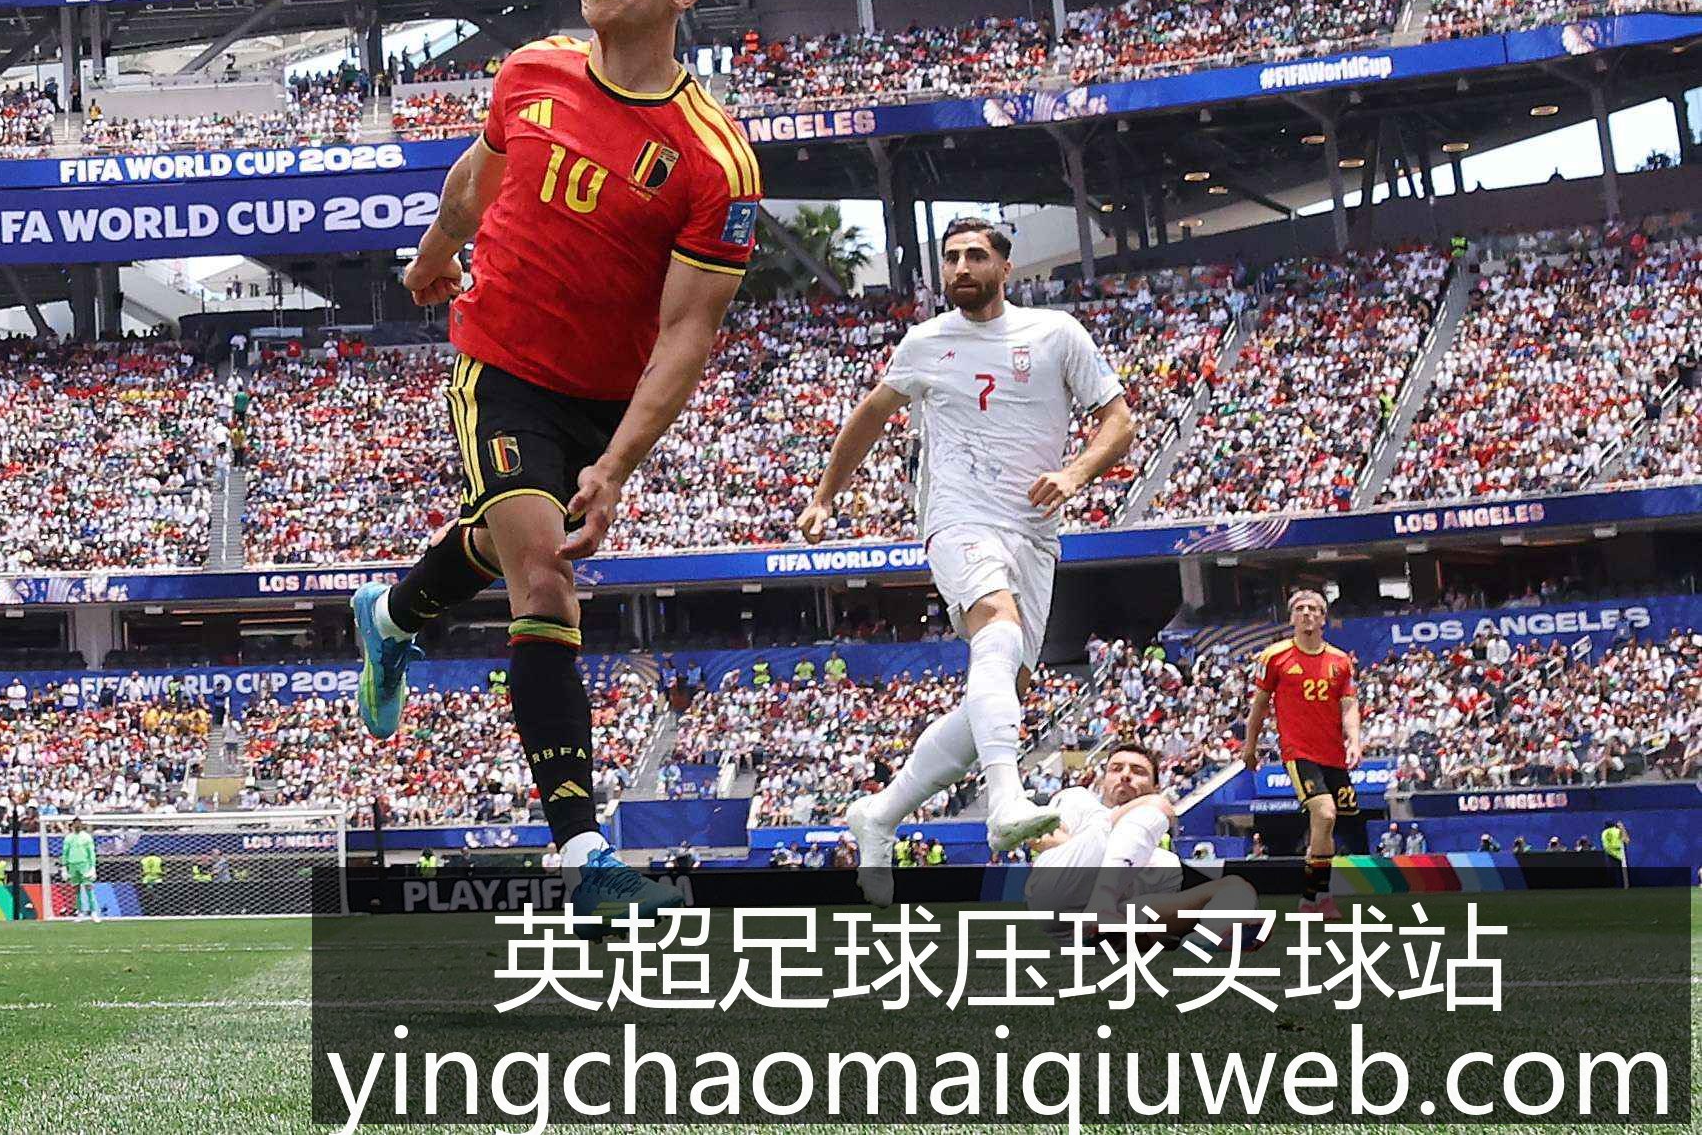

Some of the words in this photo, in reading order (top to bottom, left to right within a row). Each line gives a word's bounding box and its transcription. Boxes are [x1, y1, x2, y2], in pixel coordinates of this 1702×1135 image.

[1259, 55, 1392, 90] #FIFAWorldCup
[59, 157, 124, 184] FIFA
[126, 153, 234, 181] WORLD
[236, 150, 296, 175] CUP
[298, 144, 406, 173] 2026
[540, 143, 609, 215] 10
[56, 205, 219, 240] WORLD
[227, 198, 316, 235] CUP
[975, 373, 996, 412] 7
[1394, 512, 1438, 534] LOS
[1443, 502, 1545, 530] ANGELES
[767, 554, 812, 573] FIFA
[812, 548, 887, 570] WORLD
[258, 575, 300, 593] LOS
[1392, 618, 1464, 644] LOS
[1303, 679, 1329, 702] 22
[1459, 794, 1491, 812] LOS
